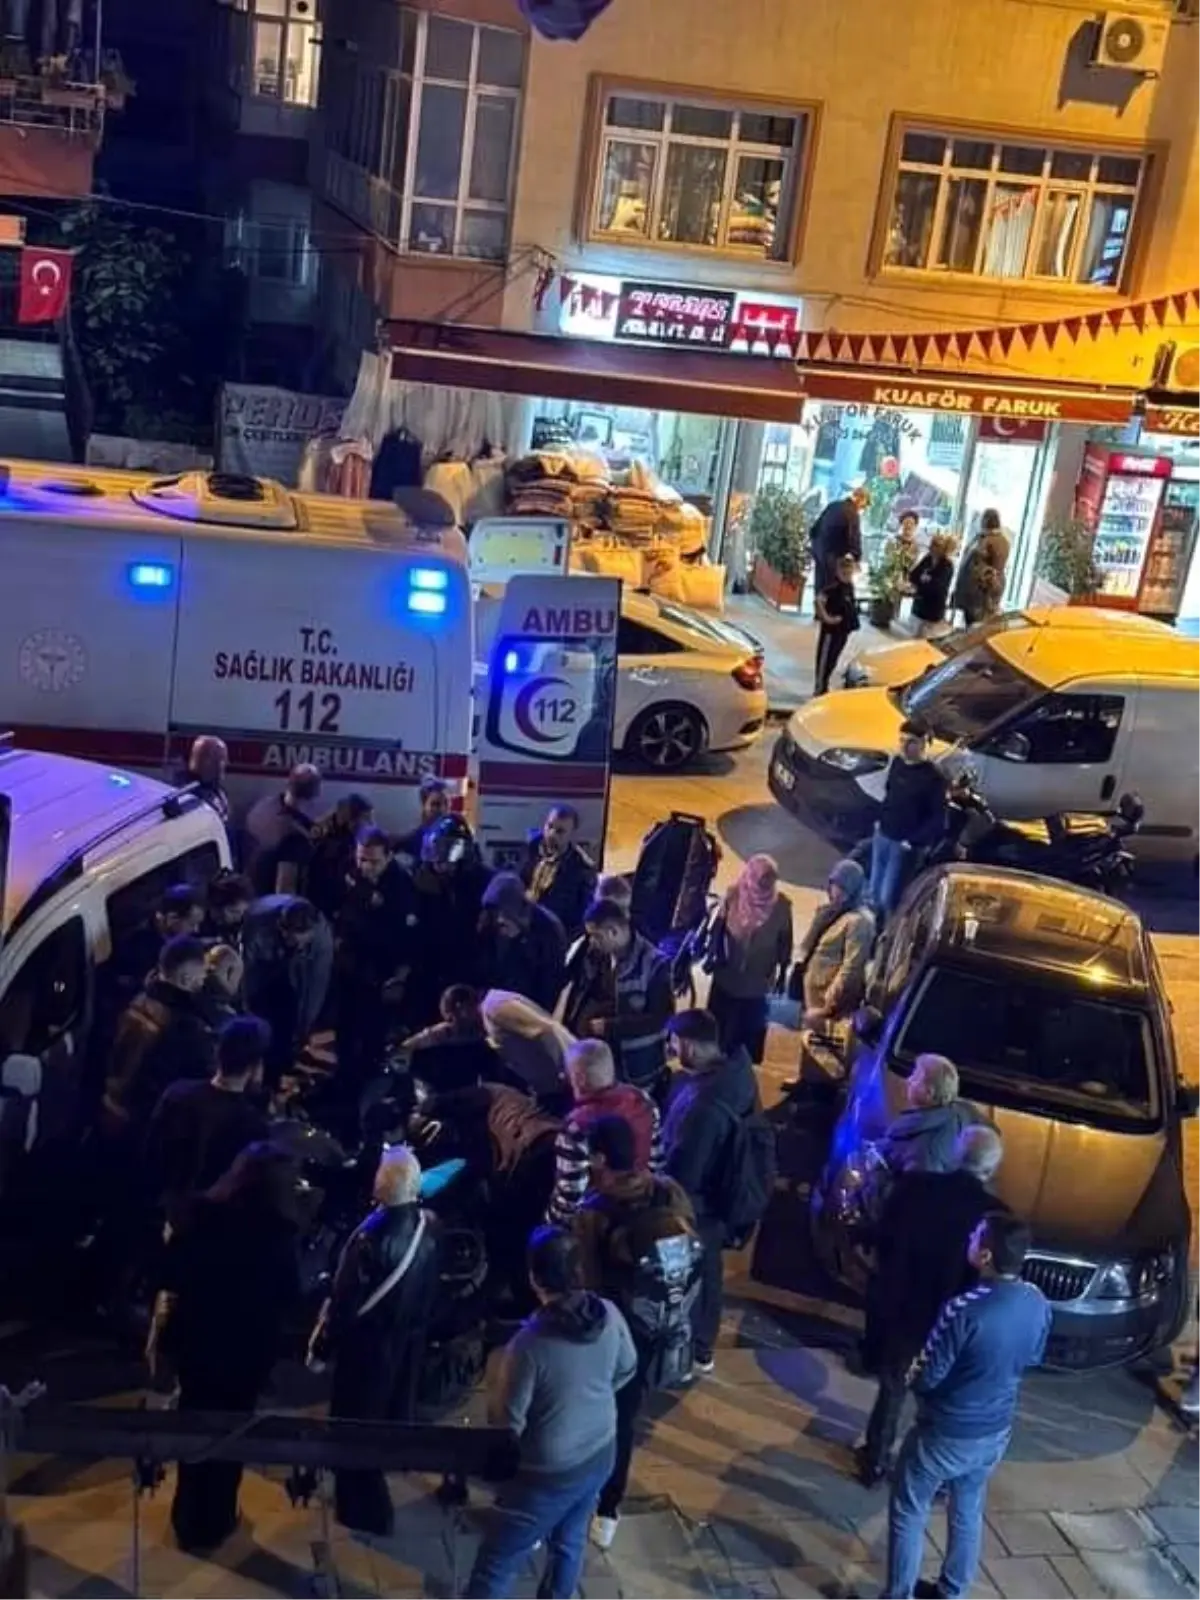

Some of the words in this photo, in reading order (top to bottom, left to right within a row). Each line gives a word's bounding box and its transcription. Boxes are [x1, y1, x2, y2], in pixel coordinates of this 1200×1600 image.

[873, 387, 973, 410] KUAFÖR
[981, 396, 1061, 417] FARUK
[521, 606, 616, 635] AMBU
[299, 627, 338, 656] T.C.
[214, 649, 295, 684] SAĞLIK
[300, 658, 415, 693] BAKANLIĞI
[274, 688, 342, 733] 112
[533, 697, 577, 724] 112
[262, 743, 437, 777] AMBULANS
